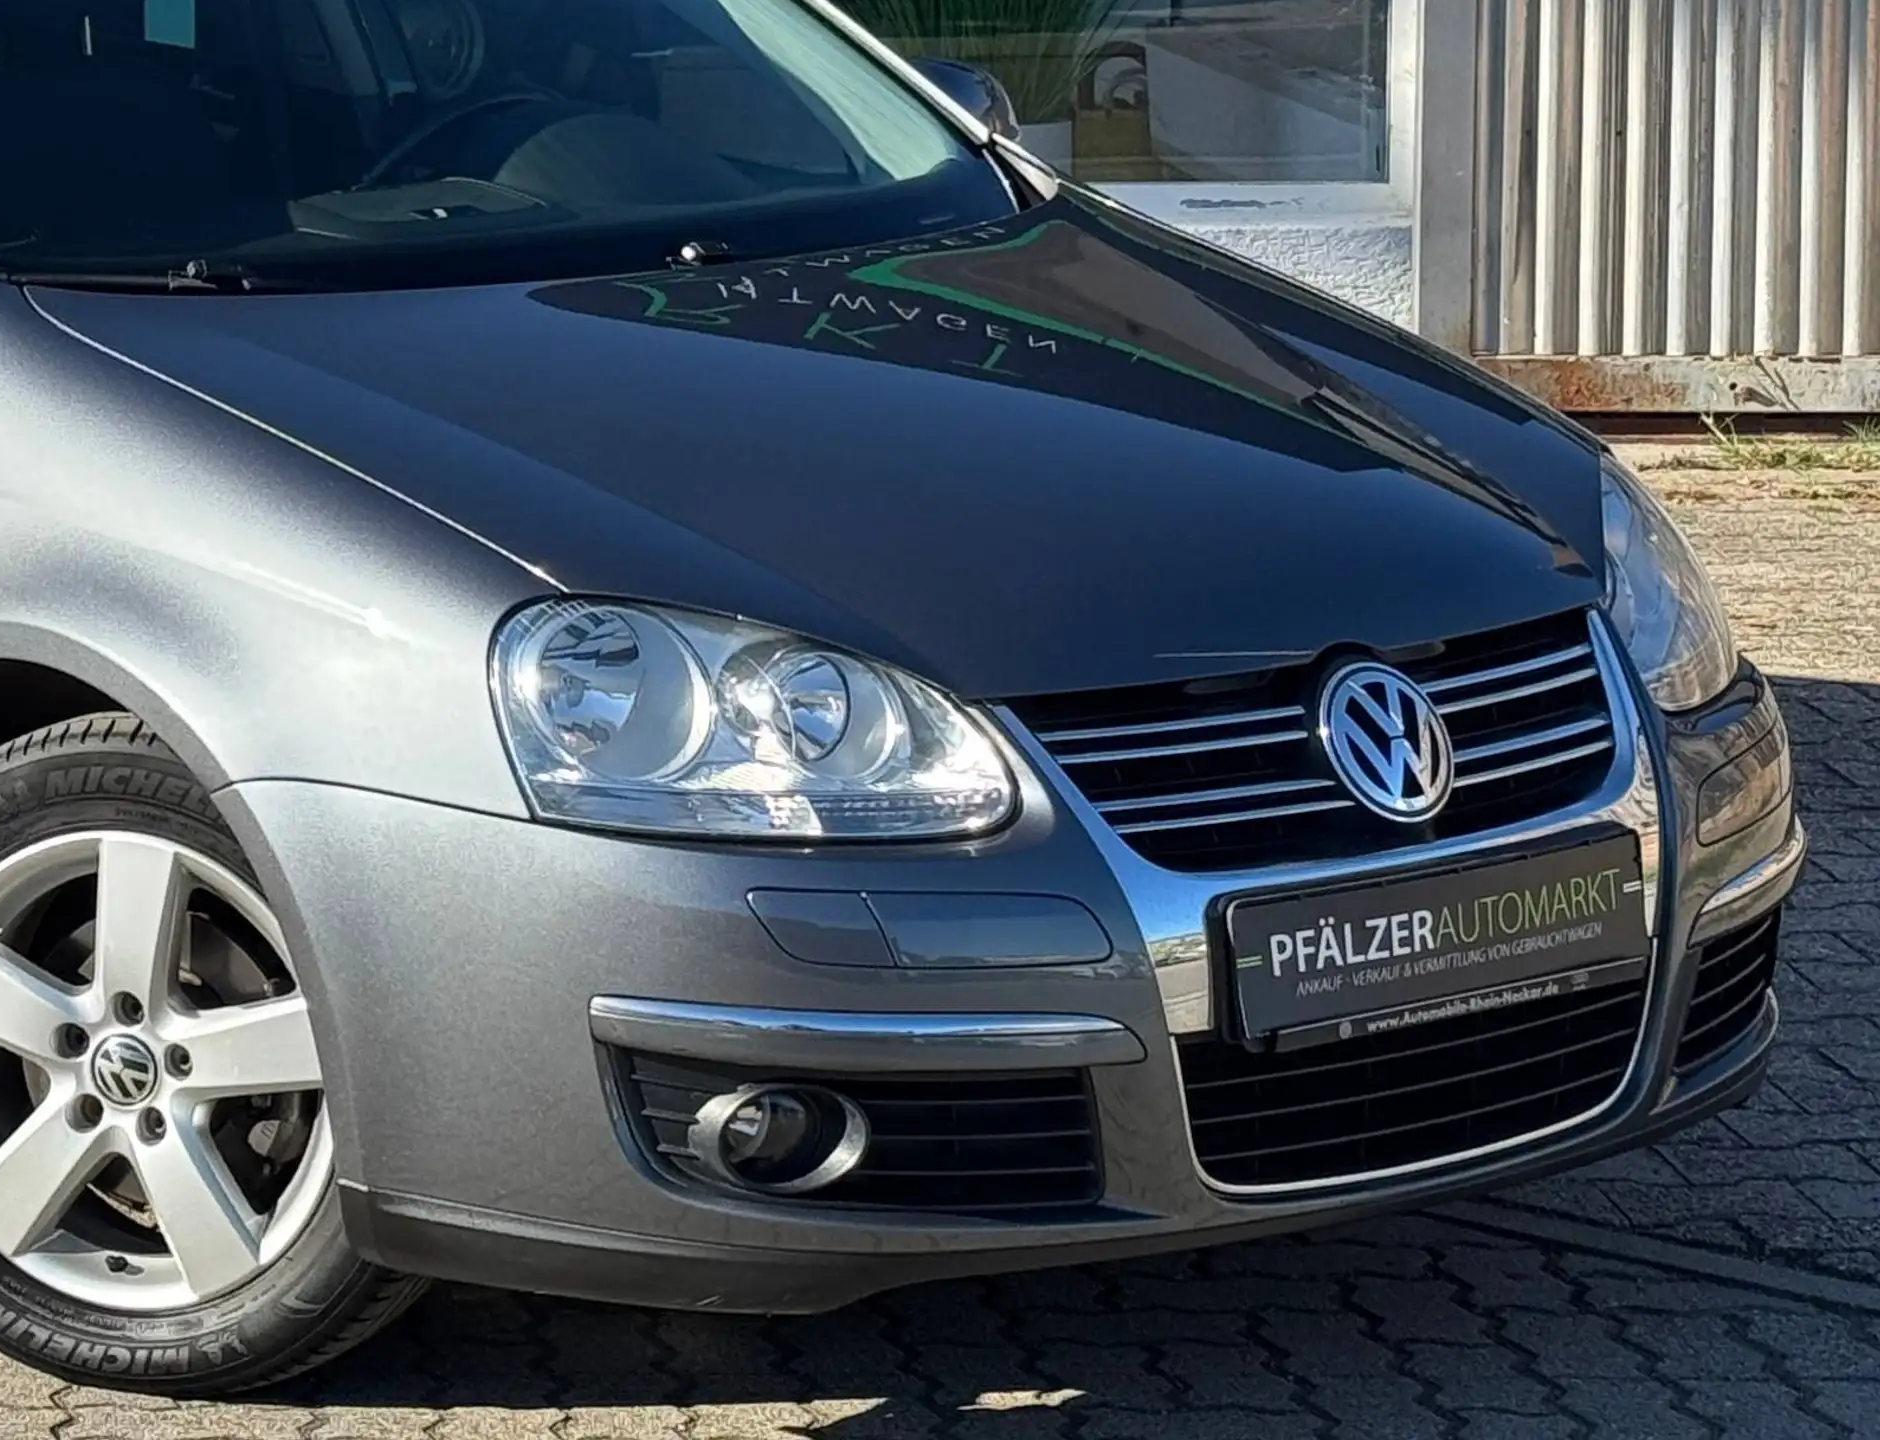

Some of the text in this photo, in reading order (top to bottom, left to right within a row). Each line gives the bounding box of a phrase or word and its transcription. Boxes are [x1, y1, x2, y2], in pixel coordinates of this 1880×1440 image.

[1296, 975, 1343, 998] ANKAUF
[1352, 965, 1403, 986] VERKAUF
[1489, 943, 1511, 961] VON
[1512, 922, 1602, 955] GEBRAUCHTWAGEN
